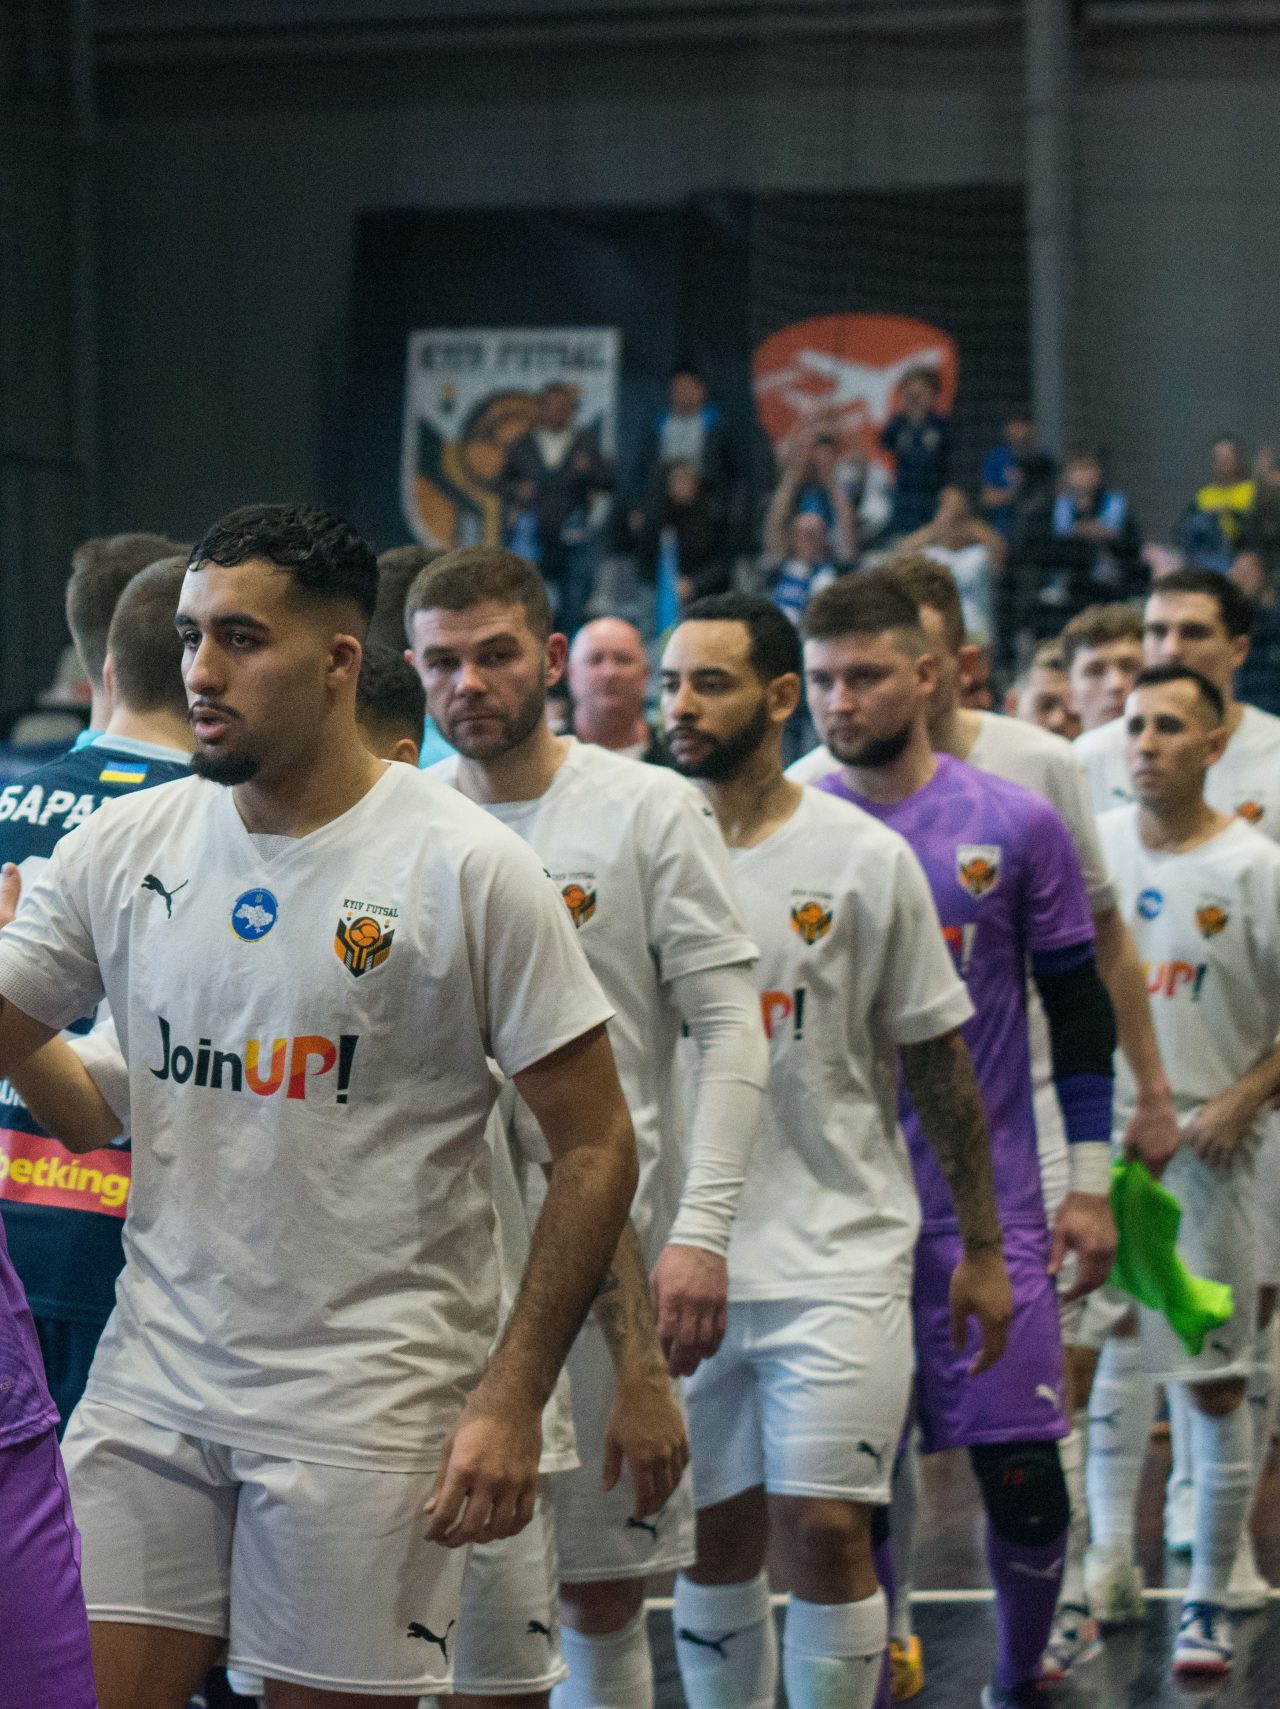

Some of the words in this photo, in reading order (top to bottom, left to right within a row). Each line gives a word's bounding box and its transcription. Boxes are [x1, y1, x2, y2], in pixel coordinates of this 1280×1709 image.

[343, 899, 364, 911] KYIV
[366, 903, 399, 918] FUTSAL
[149, 1016, 359, 1104] JoinUP!
